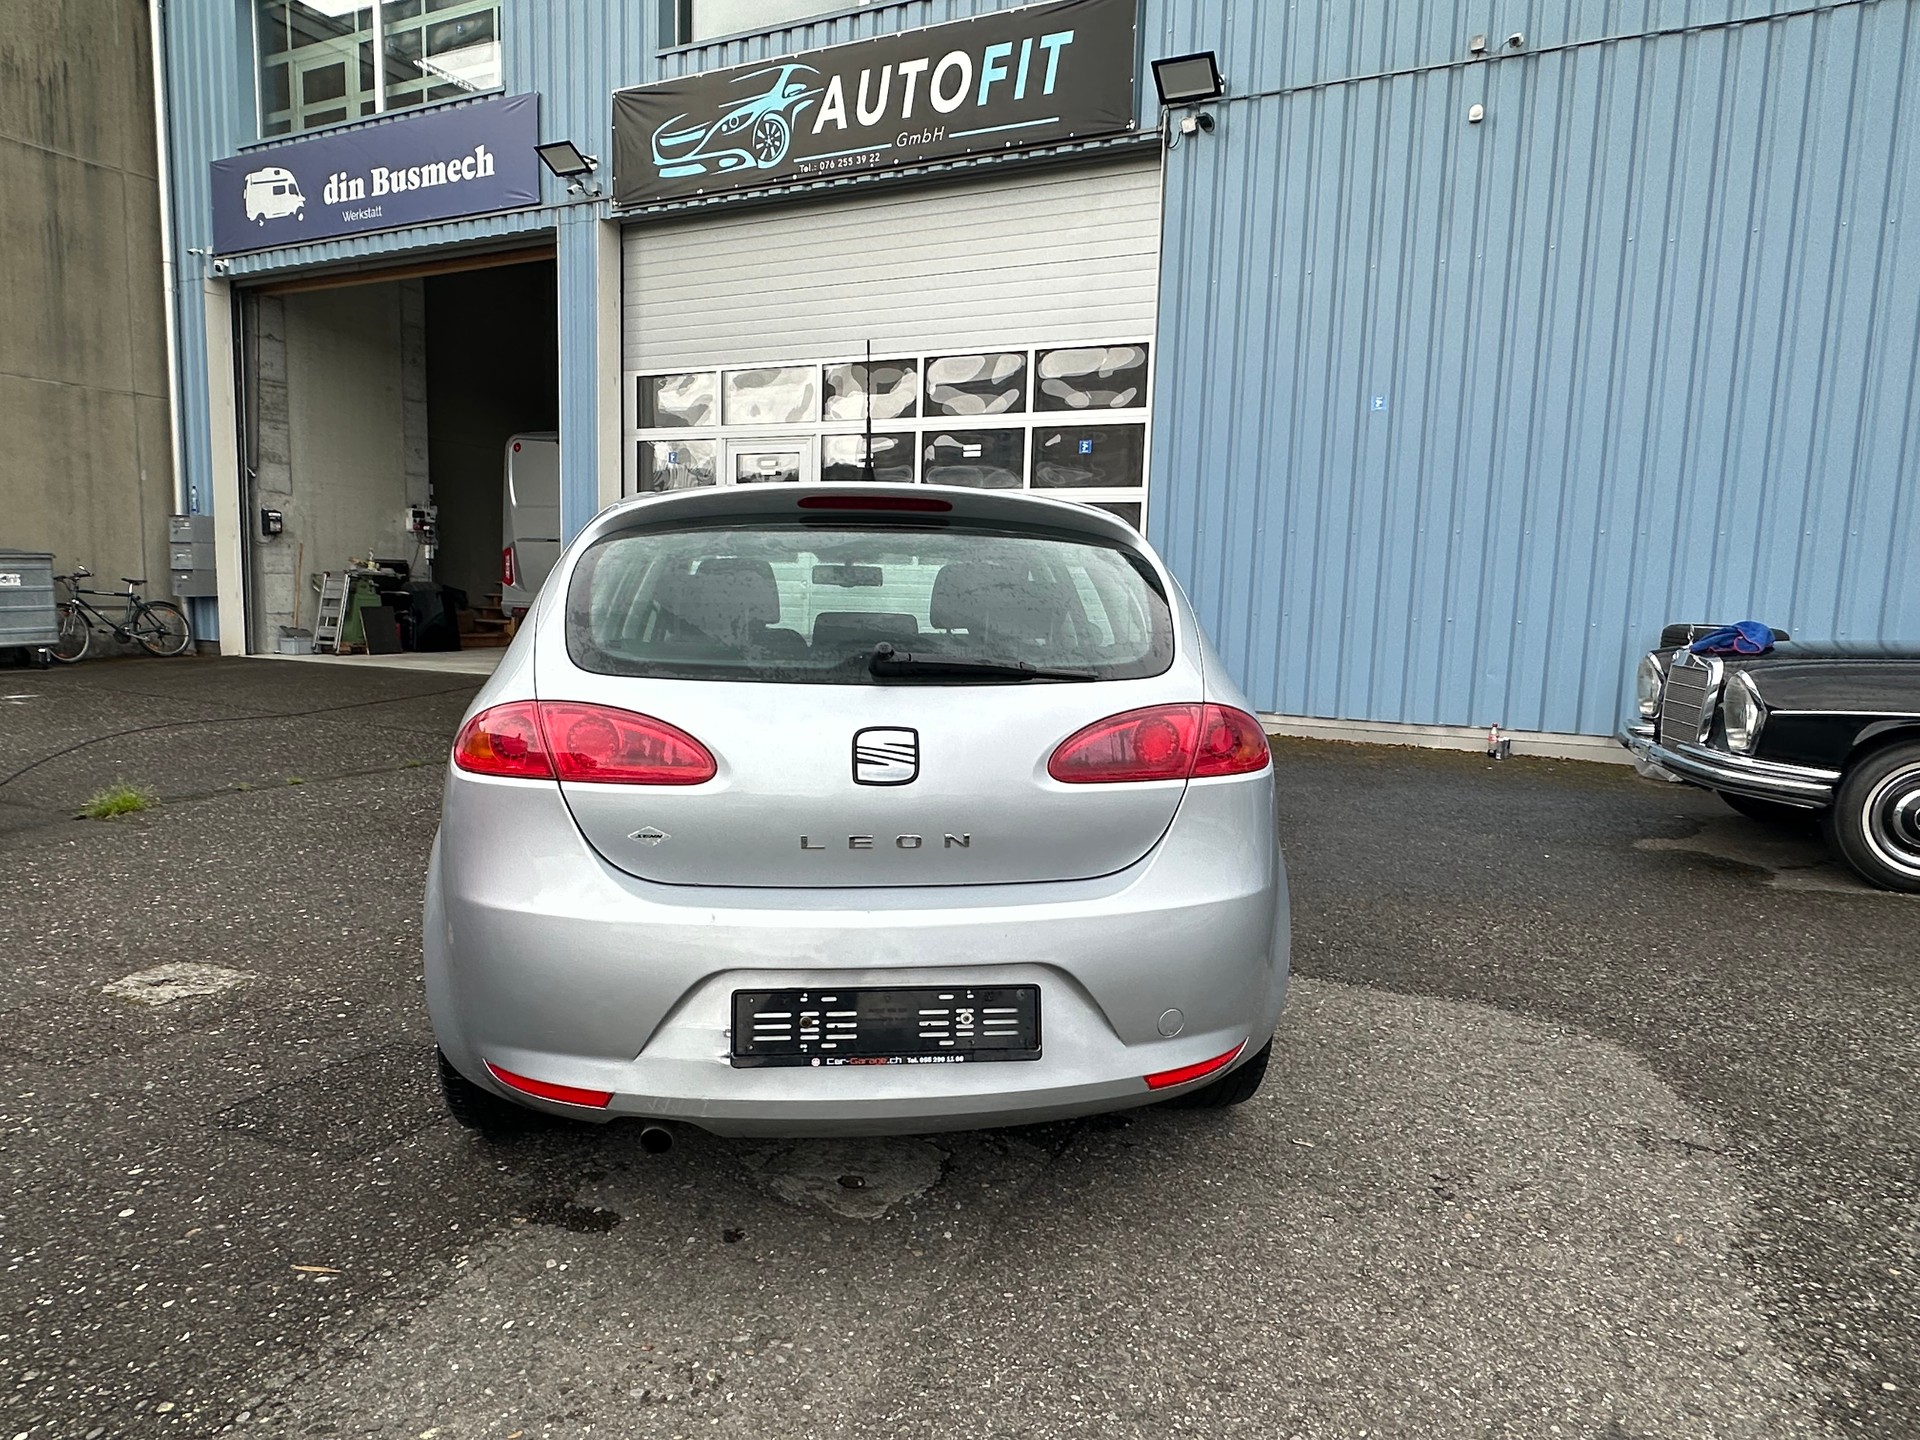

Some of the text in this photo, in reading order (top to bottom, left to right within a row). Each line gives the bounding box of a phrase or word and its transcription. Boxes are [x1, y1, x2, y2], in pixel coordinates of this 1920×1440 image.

[811, 30, 1075, 134] AUTOFIT
[896, 126, 945, 148] GmbH
[820, 159, 836, 171] 076
[837, 156, 854, 168] 255
[855, 153, 868, 165] 39
[869, 151, 881, 163] 22
[323, 144, 496, 206] din Busmech
[341, 206, 383, 223] Werkstatt
[799, 833, 972, 850] LEON
